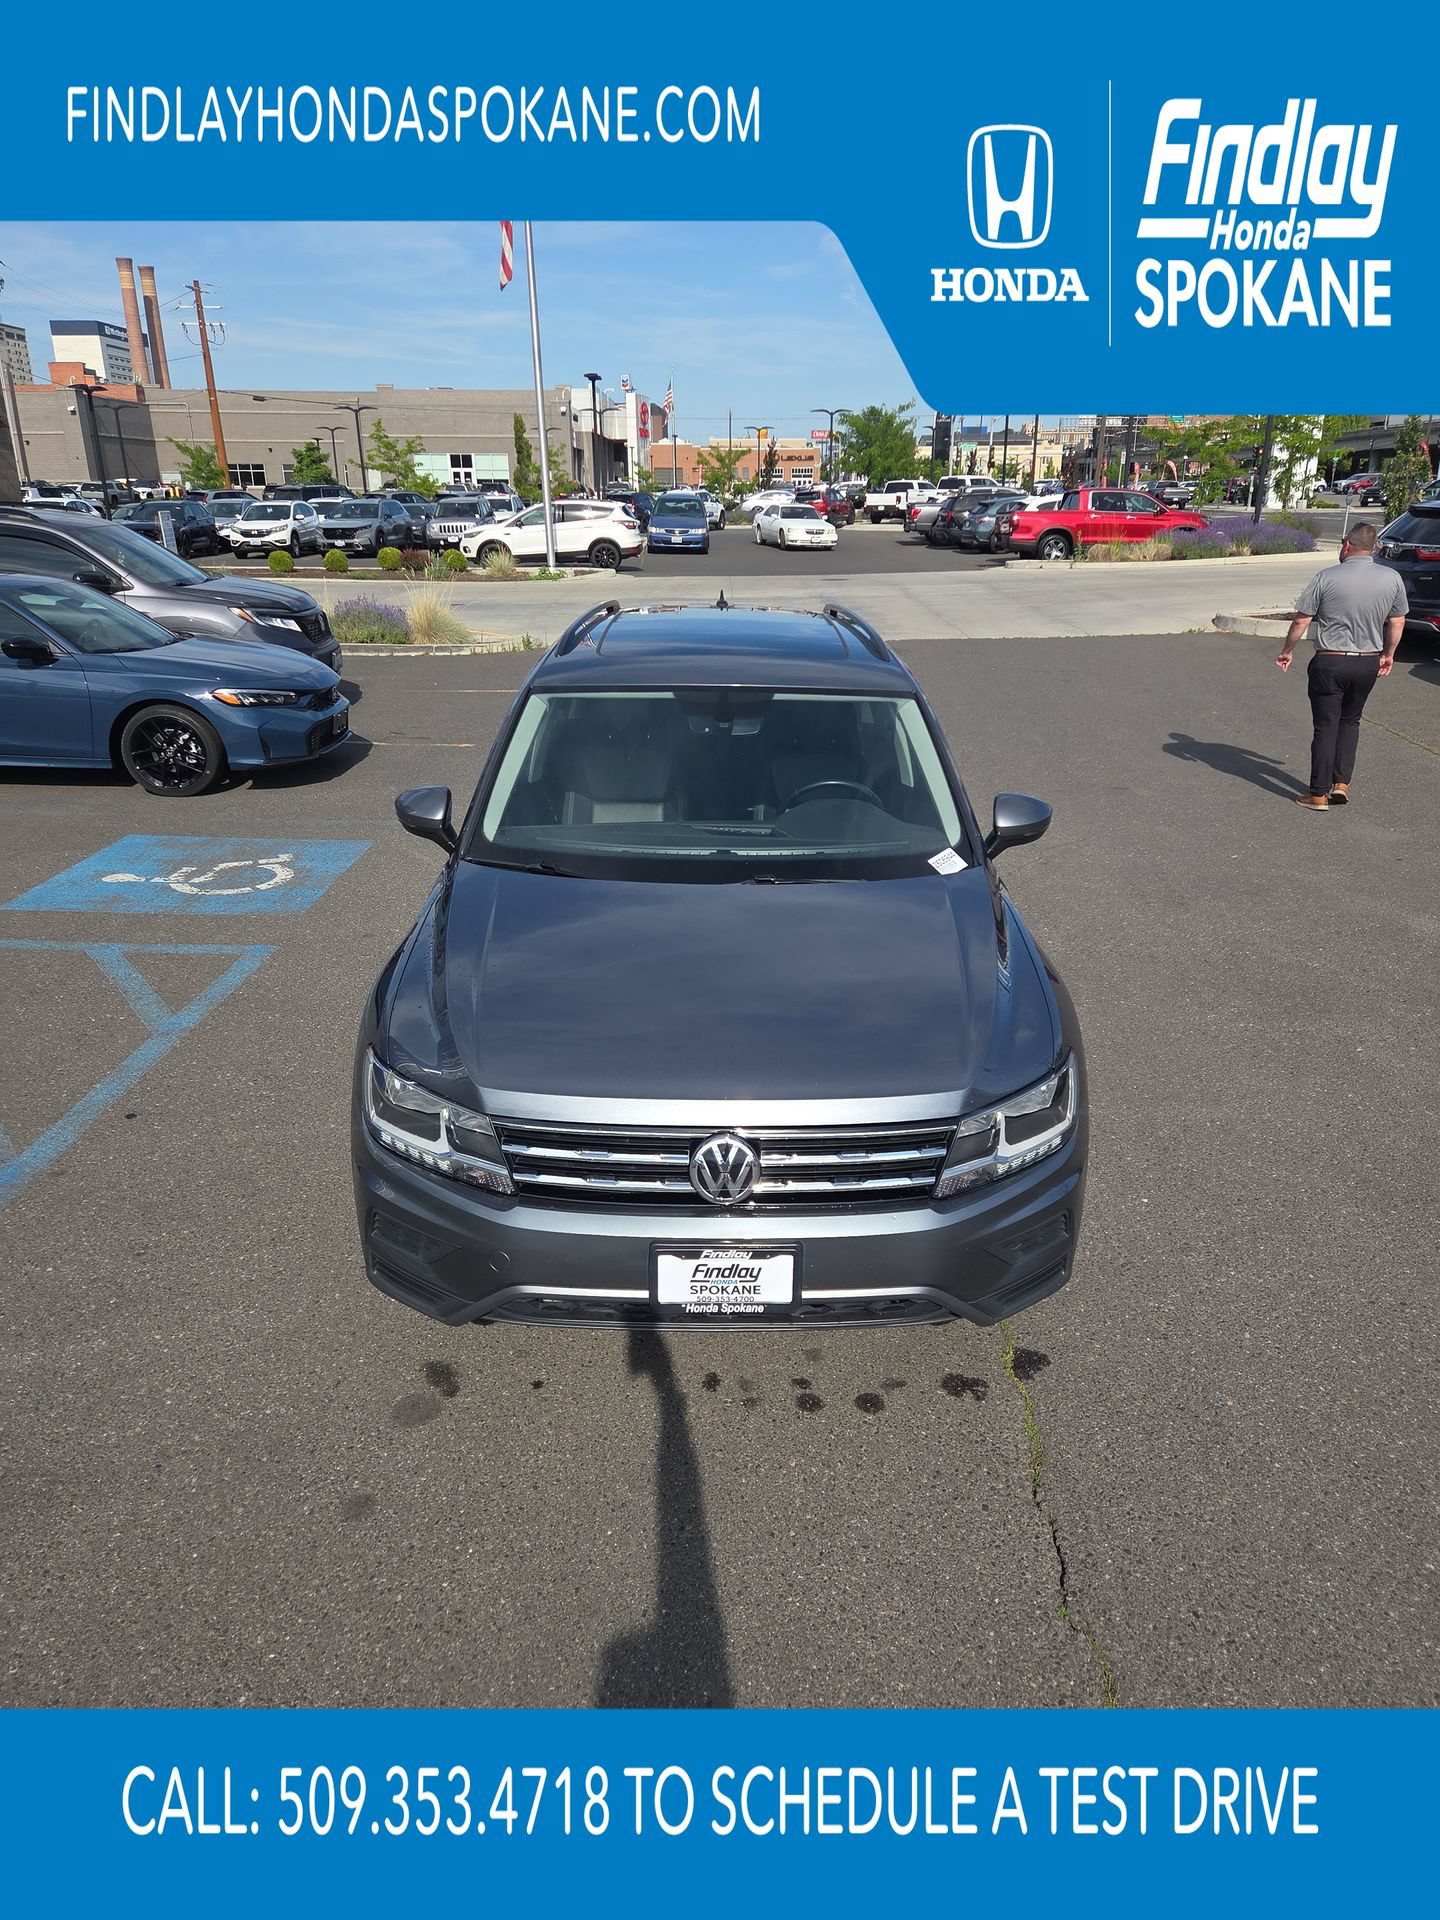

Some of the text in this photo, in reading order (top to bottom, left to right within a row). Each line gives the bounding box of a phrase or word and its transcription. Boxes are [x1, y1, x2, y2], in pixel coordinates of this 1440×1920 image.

[699, 1249, 753, 1260] Findlay
[690, 1263, 762, 1283] Findlay
[690, 1285, 762, 1295] SPOKANE
